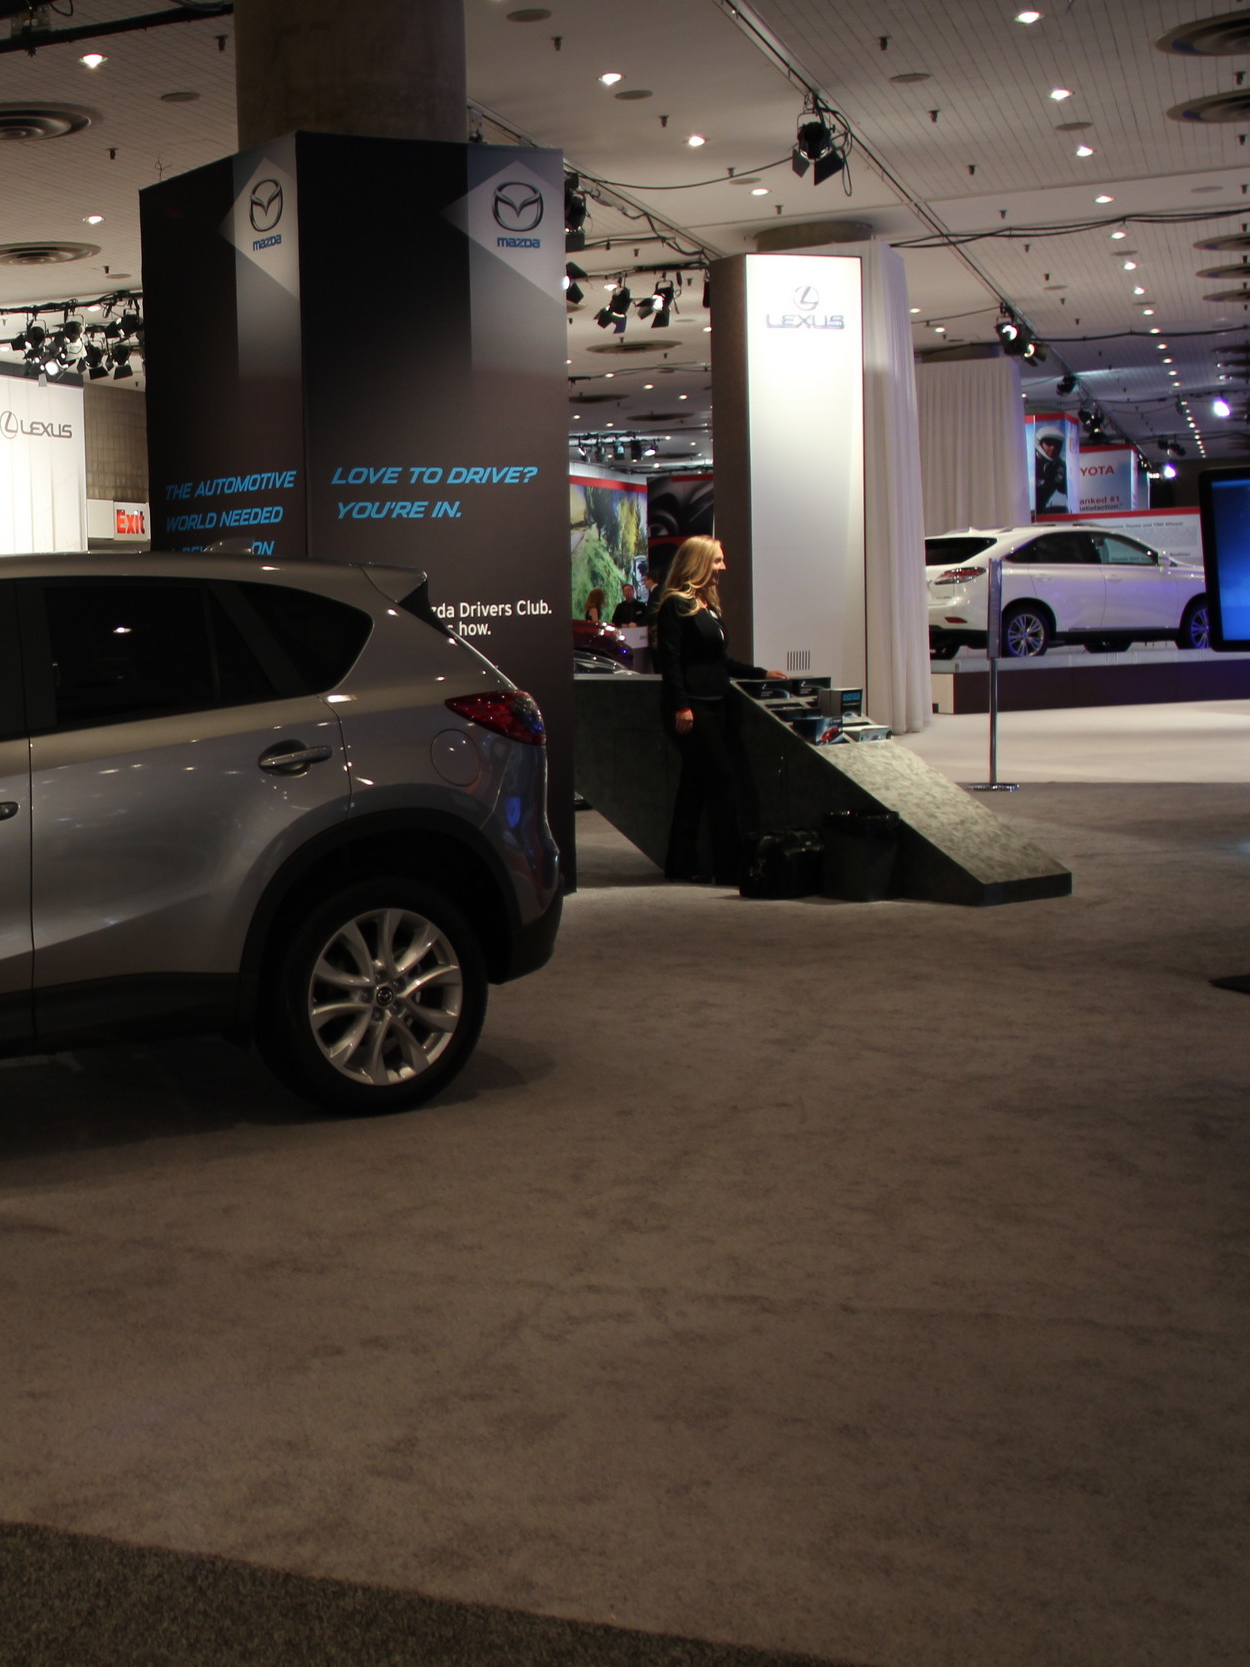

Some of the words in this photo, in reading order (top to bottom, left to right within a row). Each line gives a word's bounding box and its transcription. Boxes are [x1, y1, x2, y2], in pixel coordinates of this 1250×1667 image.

[253, 234, 282, 251] mazda
[497, 236, 541, 248] mazda
[766, 314, 845, 329] LEXUS
[20, 419, 72, 438] LEXUS
[331, 467, 402, 484] LOVE
[409, 467, 443, 484] TO
[447, 466, 538, 484] DRIVE?
[1080, 465, 1115, 477] YOTA
[165, 482, 193, 500] THE
[194, 470, 297, 498] AUTOMOTIVE
[1079, 496, 1108, 506] anked
[337, 501, 429, 519] YOU'RE
[431, 501, 463, 518] IN.
[116, 509, 146, 534] Exit
[166, 512, 217, 532] WORLD
[219, 506, 284, 527] NEEDED
[459, 602, 513, 617] Drivers
[516, 600, 553, 616] Club.
[459, 621, 492, 636] how.
